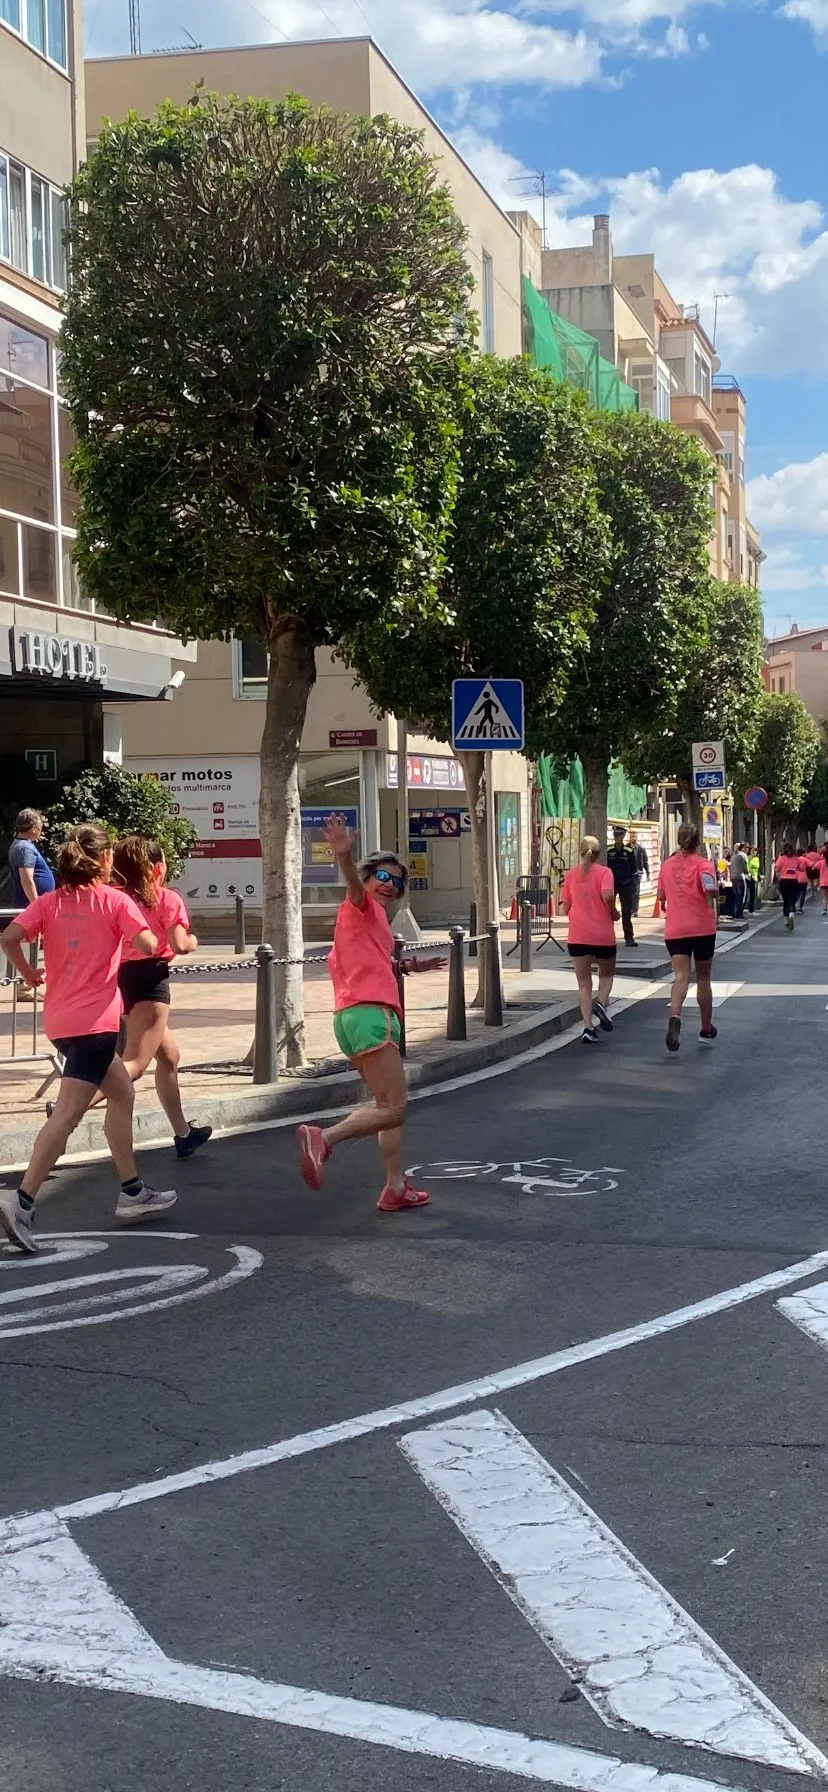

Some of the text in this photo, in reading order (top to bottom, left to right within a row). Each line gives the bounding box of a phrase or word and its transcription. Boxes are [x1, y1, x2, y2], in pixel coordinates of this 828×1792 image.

[24, 631, 107, 681] HOTEL
[35, 755, 48, 770] H
[182, 768, 233, 781] motos
[183, 784, 231, 792] multimarca
